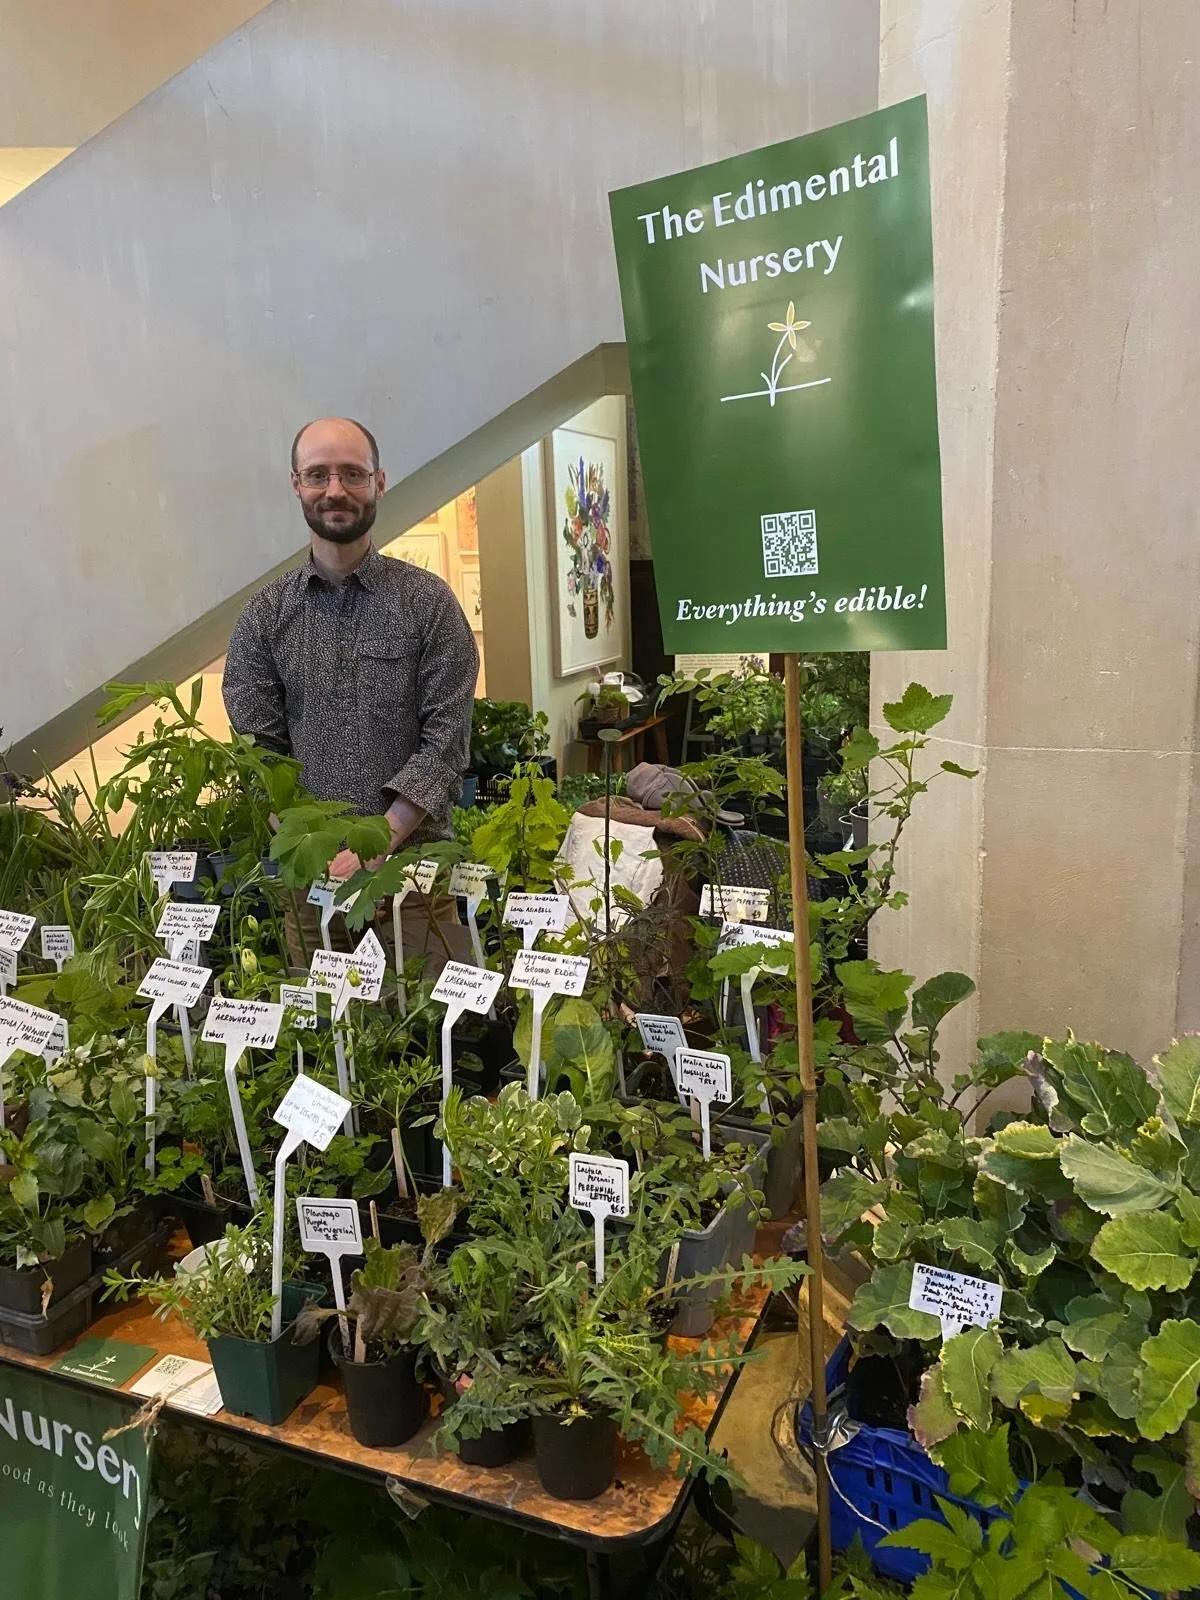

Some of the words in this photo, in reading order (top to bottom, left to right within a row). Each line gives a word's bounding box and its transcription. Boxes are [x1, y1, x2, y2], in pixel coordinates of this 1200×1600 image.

[637, 204, 704, 244] The
[712, 136, 899, 227] Edimental
[700, 235, 843, 293] Nursery
[834, 584, 928, 614] edible!
[215, 1013, 257, 1026] ARROWHEAD
[205, 1029, 225, 1039] tubers
[682, 1057, 703, 1068] Aralia
[577, 1182, 615, 1195] PERENNIAL
[590, 1192, 621, 1203] LETTUCE
[305, 1207, 340, 1220] Plantago
[917, 1265, 956, 1281] PERENNIAL
[963, 1278, 988, 1290] KALE
[939, 1307, 944, 1316] 3
[2, 1463, 32, 1485] ood
[38, 1480, 54, 1498] as
[60, 1491, 95, 1527] they
